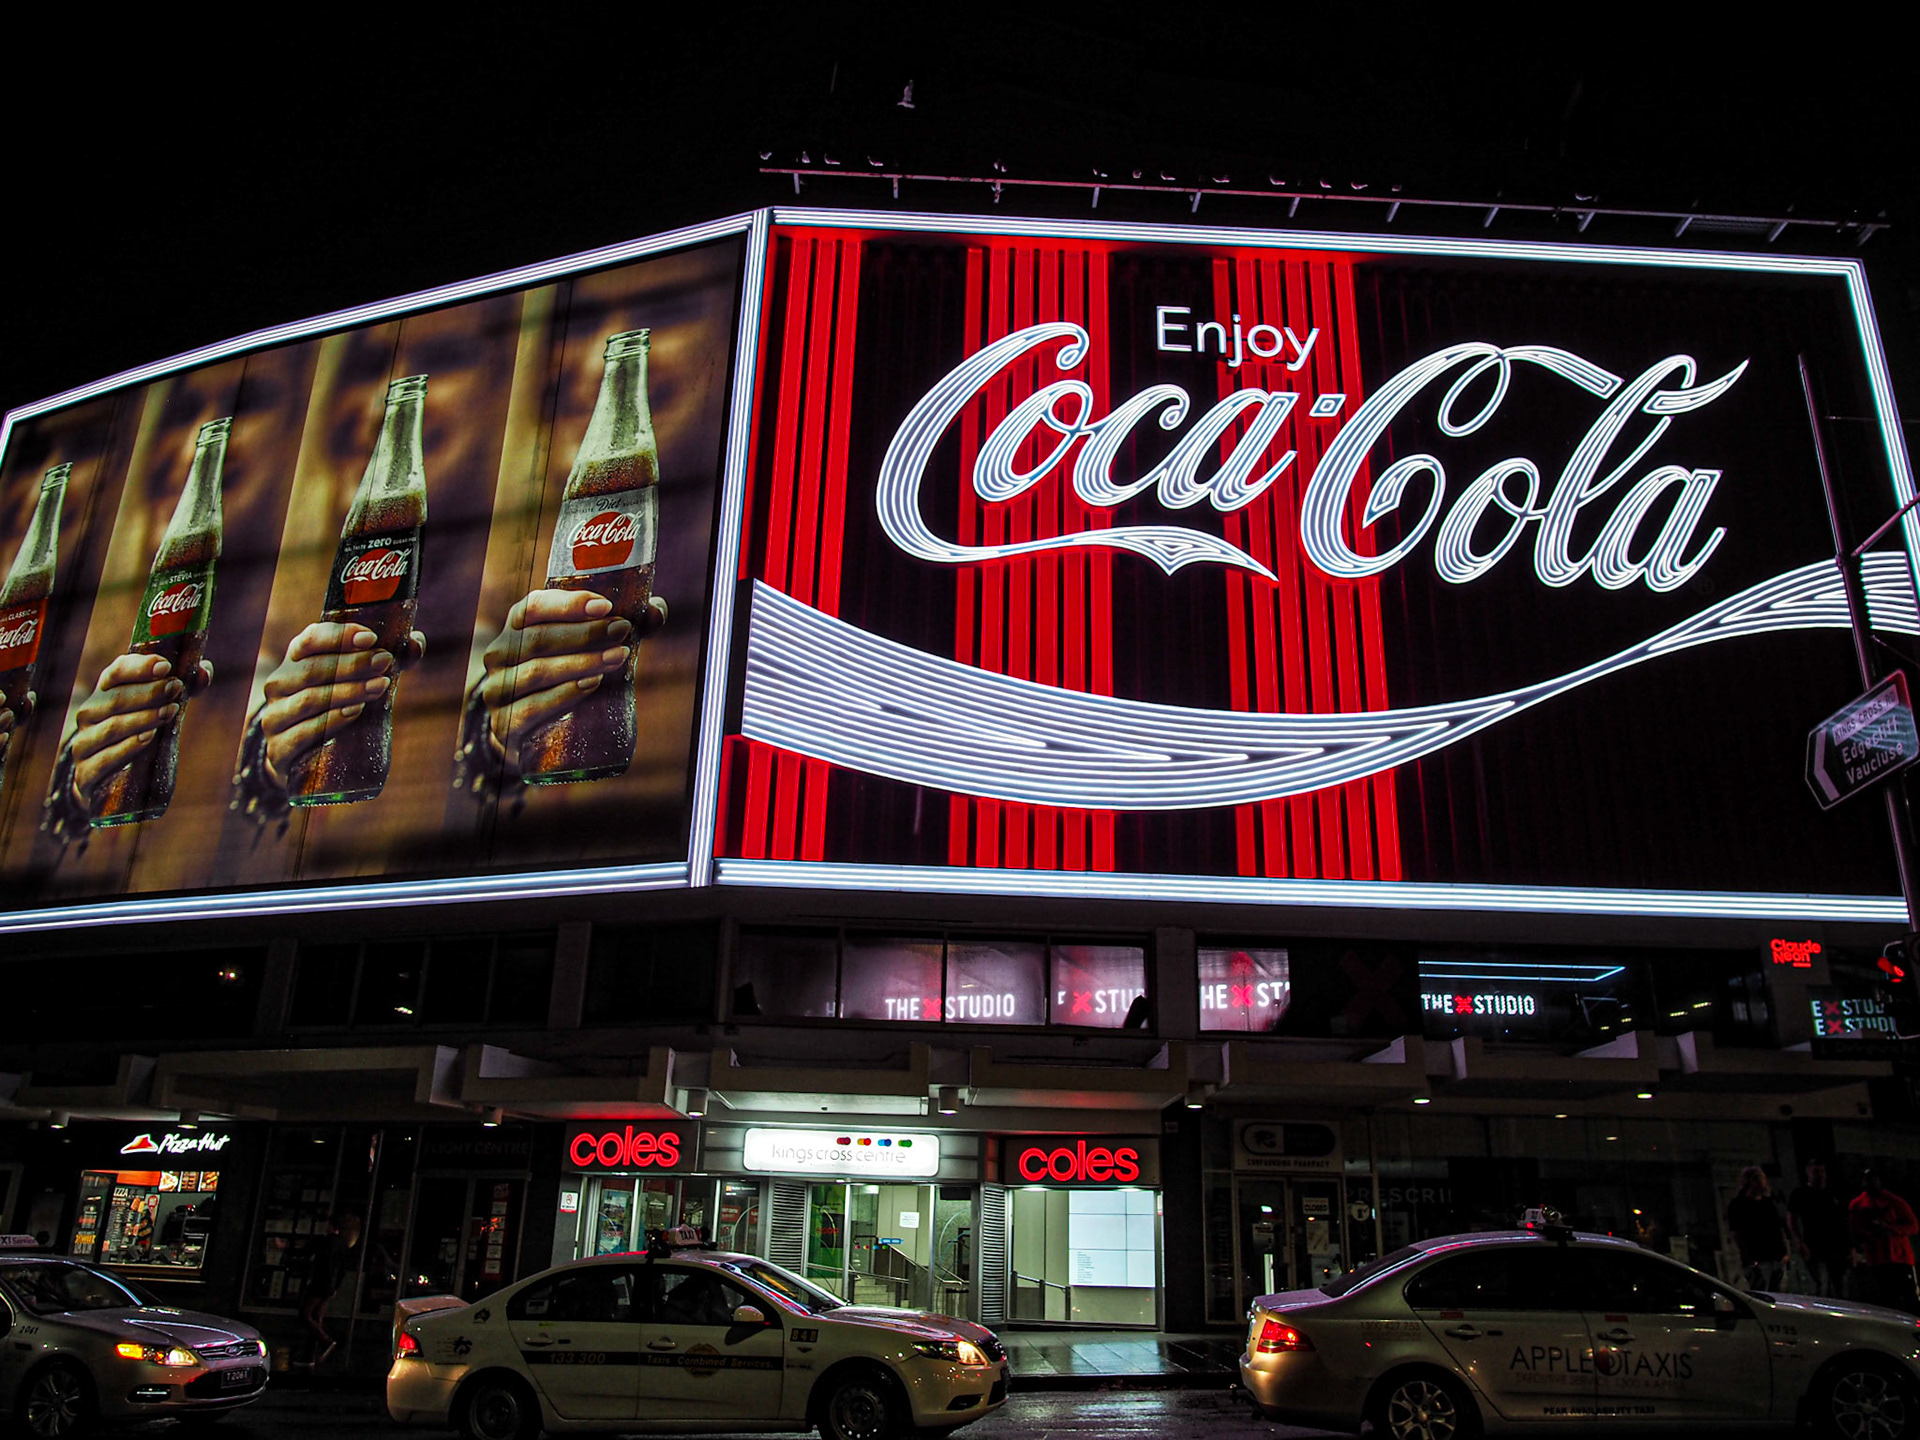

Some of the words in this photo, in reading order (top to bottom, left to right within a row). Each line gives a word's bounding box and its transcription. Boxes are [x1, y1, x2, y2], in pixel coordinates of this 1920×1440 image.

[1156, 305, 1319, 371] Enjoy
[596, 498, 622, 511] Diet
[566, 510, 644, 548] Coca-Cola
[367, 537, 392, 549] zero
[340, 548, 412, 584] Coca-Cola
[169, 571, 192, 583] STEVIA
[147, 582, 206, 617] Coca-Cola
[1833, 718, 1856, 741] KINGS
[1858, 701, 1883, 723] CROSS
[1885, 691, 1897, 707] RD
[1841, 715, 1899, 765] Edgecliff
[1846, 742, 1904, 785] Vaucluse
[1770, 938, 1821, 954] Claude
[1772, 951, 1811, 964] Neon
[886, 998, 920, 1019] THE
[945, 993, 1015, 1019] STUDIO
[1420, 993, 1454, 1013] THE
[1474, 994, 1536, 1015] STUDIO
[157, 1132, 197, 1155] Pizza
[197, 1132, 230, 1152] Hut
[474, 1141, 529, 1155] CENTRE
[569, 1125, 680, 1167] coles
[772, 1144, 813, 1163] kings
[815, 1149, 853, 1162] cross
[856, 1149, 907, 1163] centre
[1018, 1140, 1140, 1181] coles
[1347, 1187, 1452, 1203] PRESCRI
[1305, 1204, 1327, 1212] CLOSED
[680, 1229, 695, 1240] TAXI
[550, 1352, 577, 1364] 133
[579, 1352, 606, 1364] 300
[647, 1354, 671, 1365] Taxis
[677, 1356, 726, 1367] Combined
[1509, 1344, 1593, 1373] APPLE
[1623, 1350, 1693, 1380] TAXIS
[1544, 1406, 1568, 1414] PEAK
[1634, 1405, 1655, 1414] TAXI
